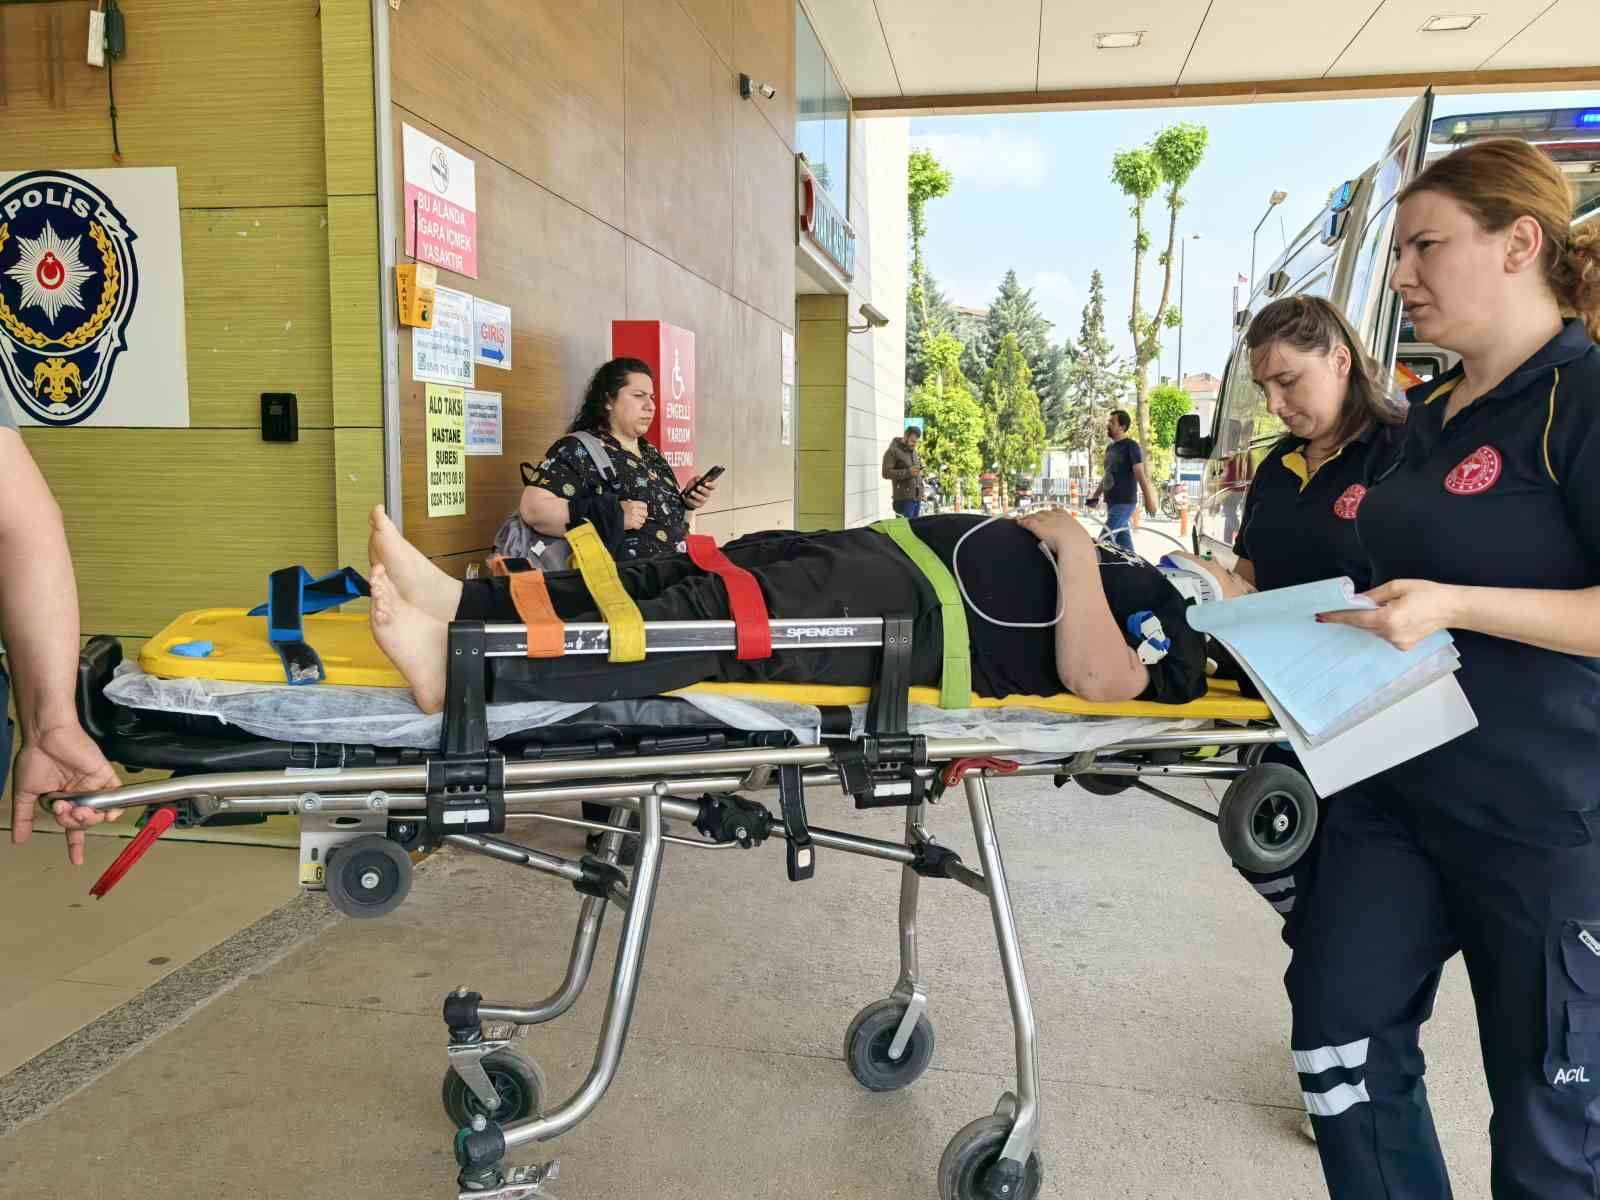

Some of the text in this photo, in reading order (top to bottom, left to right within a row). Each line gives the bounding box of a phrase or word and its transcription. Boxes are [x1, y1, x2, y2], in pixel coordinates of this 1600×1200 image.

[4, 187, 91, 220] POLİS
[417, 191, 465, 225] BU ALANDA
[429, 396, 443, 415] ALO
[432, 428, 461, 443] HASTANE
[786, 626, 855, 641] SPENGER
